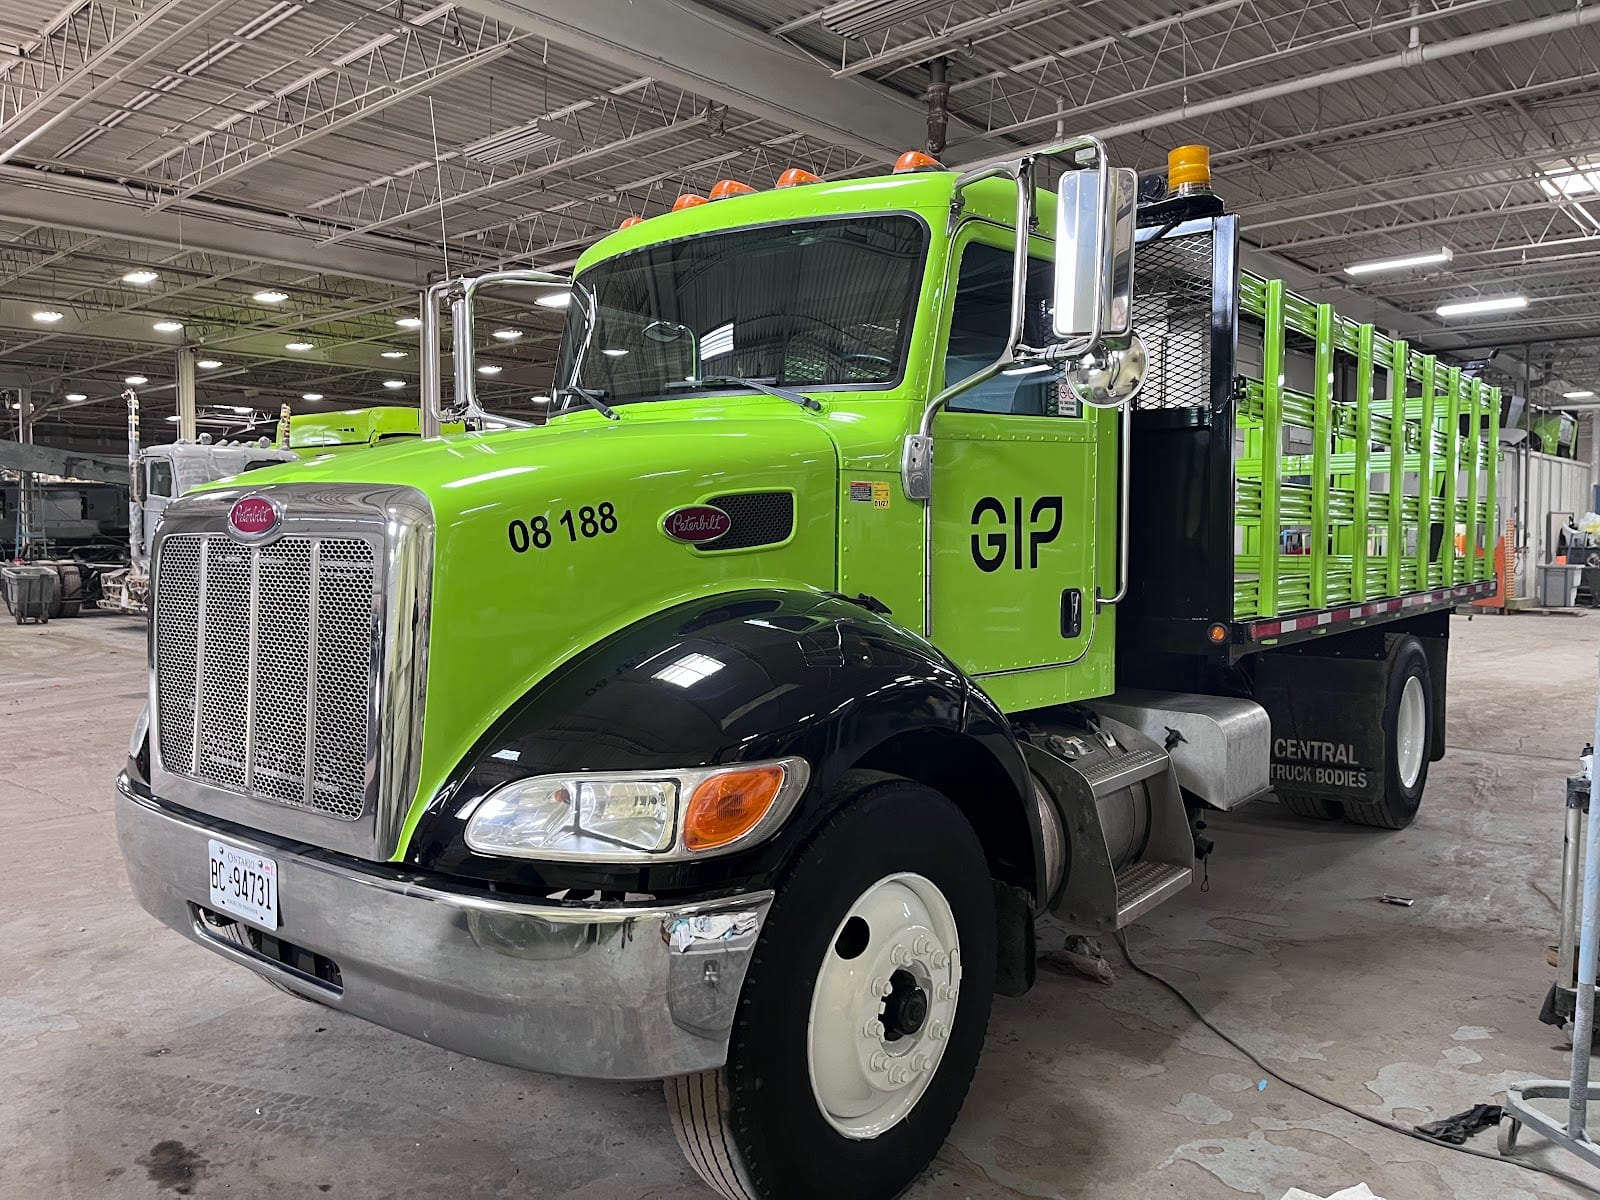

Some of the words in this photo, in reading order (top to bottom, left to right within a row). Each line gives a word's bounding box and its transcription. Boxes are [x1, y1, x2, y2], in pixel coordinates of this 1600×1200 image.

[234, 504, 272, 524] Peterbilt
[672, 513, 724, 533] Peterbilt
[508, 515, 552, 553] 08
[559, 501, 618, 542] 188
[971, 496, 1062, 572] GIP
[1274, 738, 1360, 765] CENTRAL
[1315, 767, 1368, 788] BODIES
